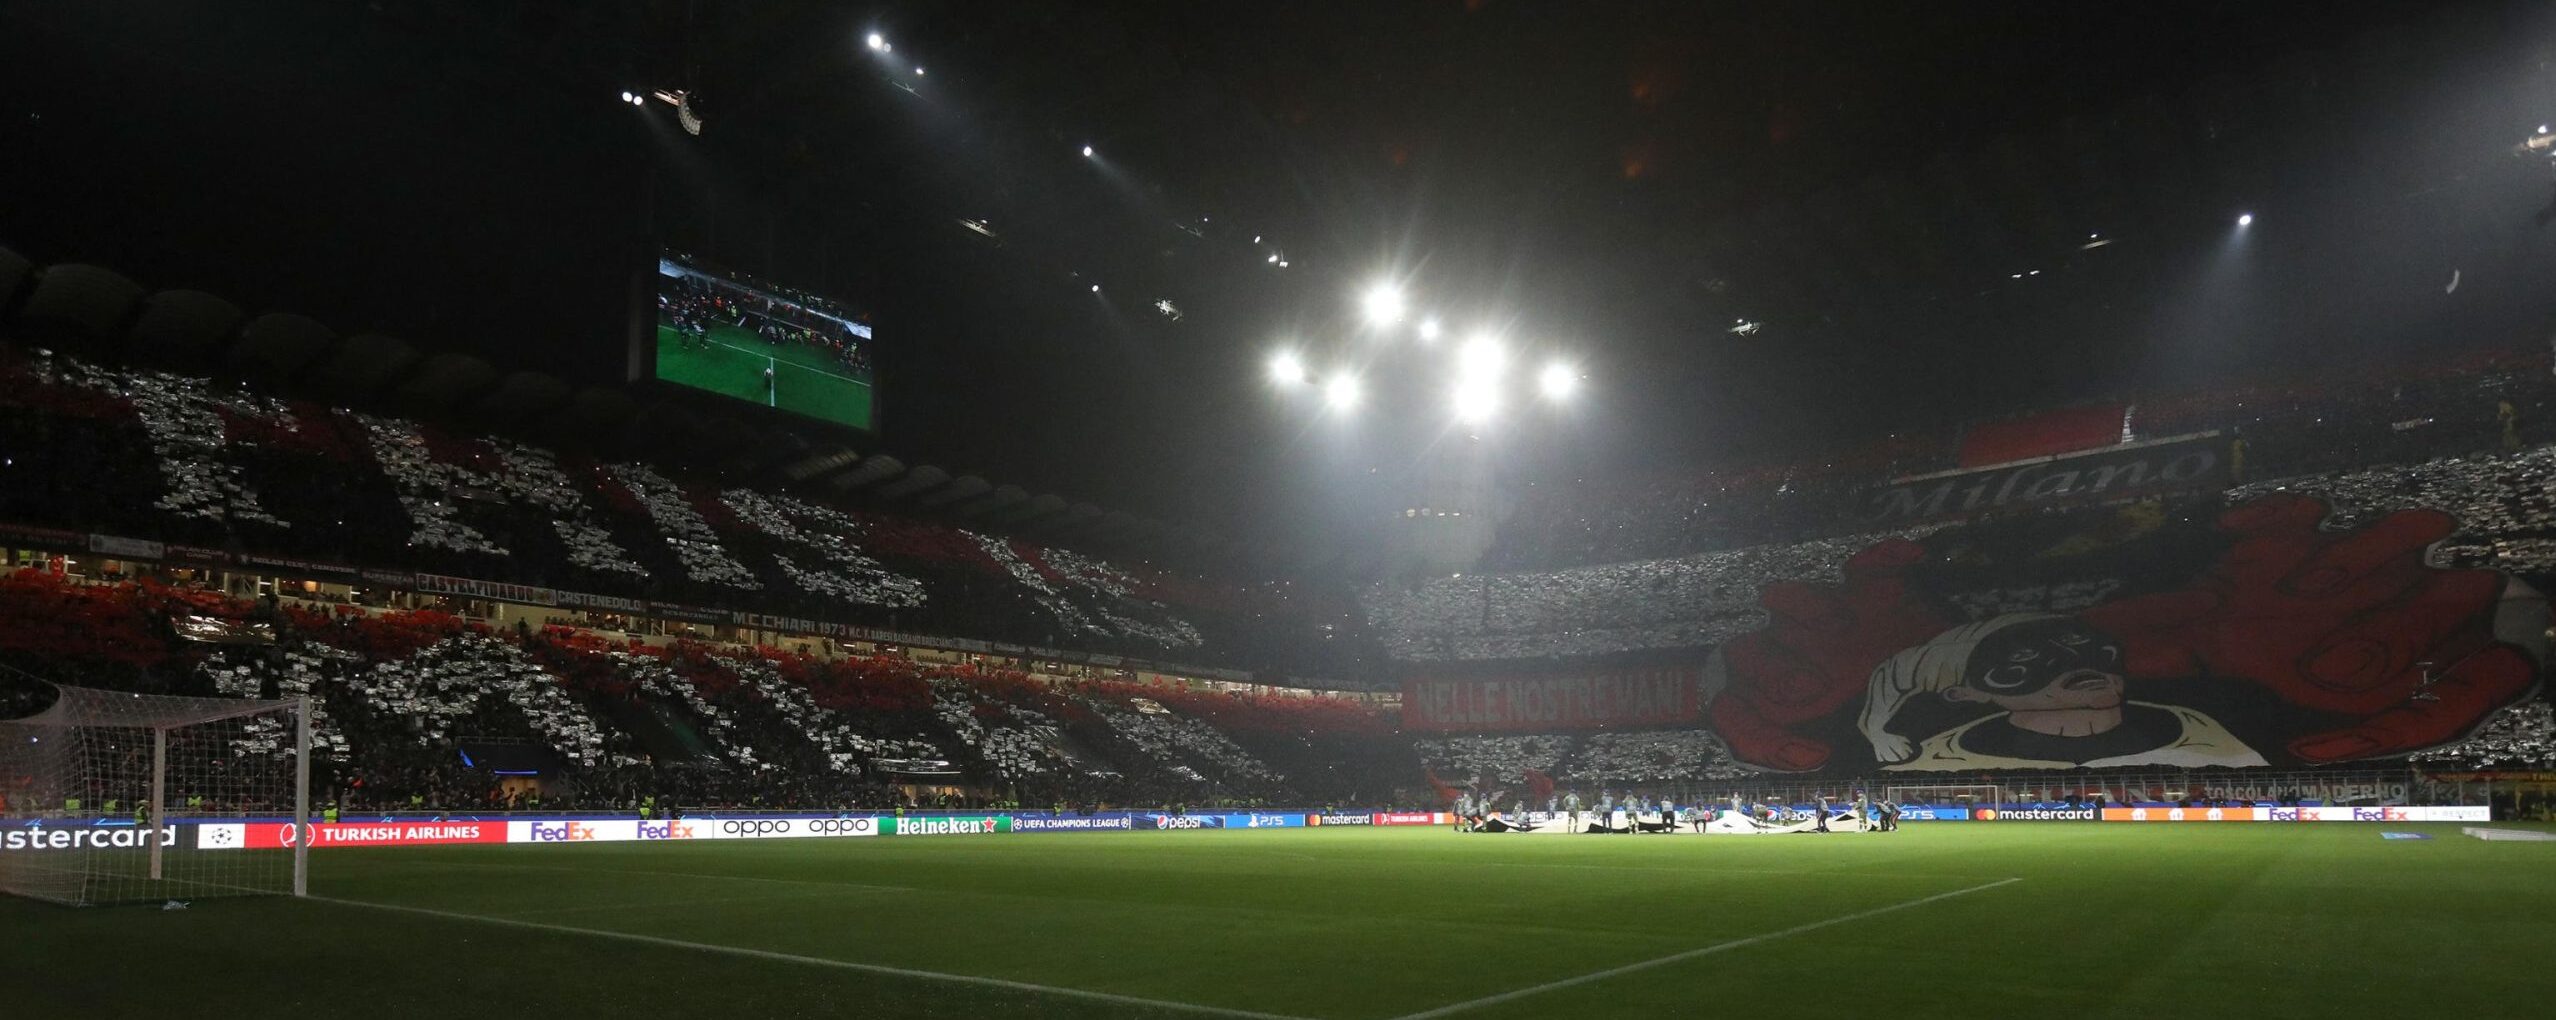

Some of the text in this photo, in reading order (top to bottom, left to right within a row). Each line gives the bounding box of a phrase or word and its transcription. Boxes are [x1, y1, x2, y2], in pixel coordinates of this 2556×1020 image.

[1864, 448, 2218, 521] Milano
[417, 574, 534, 601] CASTELFIDARDO
[558, 591, 641, 611] CASTENEDOLO
[819, 622, 847, 636] 1973
[2302, 782, 2406, 803] MADERNO
[1168, 816, 1200, 829] pepsi
[1260, 816, 1283, 826] PS5
[1322, 814, 1369, 825] mastercard
[2000, 808, 2094, 820] mastercard
[2269, 807, 2321, 821] FedEx
[2353, 807, 2407, 821] FedEx
[531, 821, 594, 841] FedEx
[637, 820, 693, 839] FedEx
[724, 819, 790, 837] oppo
[809, 819, 869, 835] oppo
[896, 817, 982, 835] Heineken
[1024, 818, 1120, 829] UEFA CHAMPIONS LEAGUE
[0, 825, 175, 849] stercard
[322, 825, 480, 842] TURKISH AIRLINES
